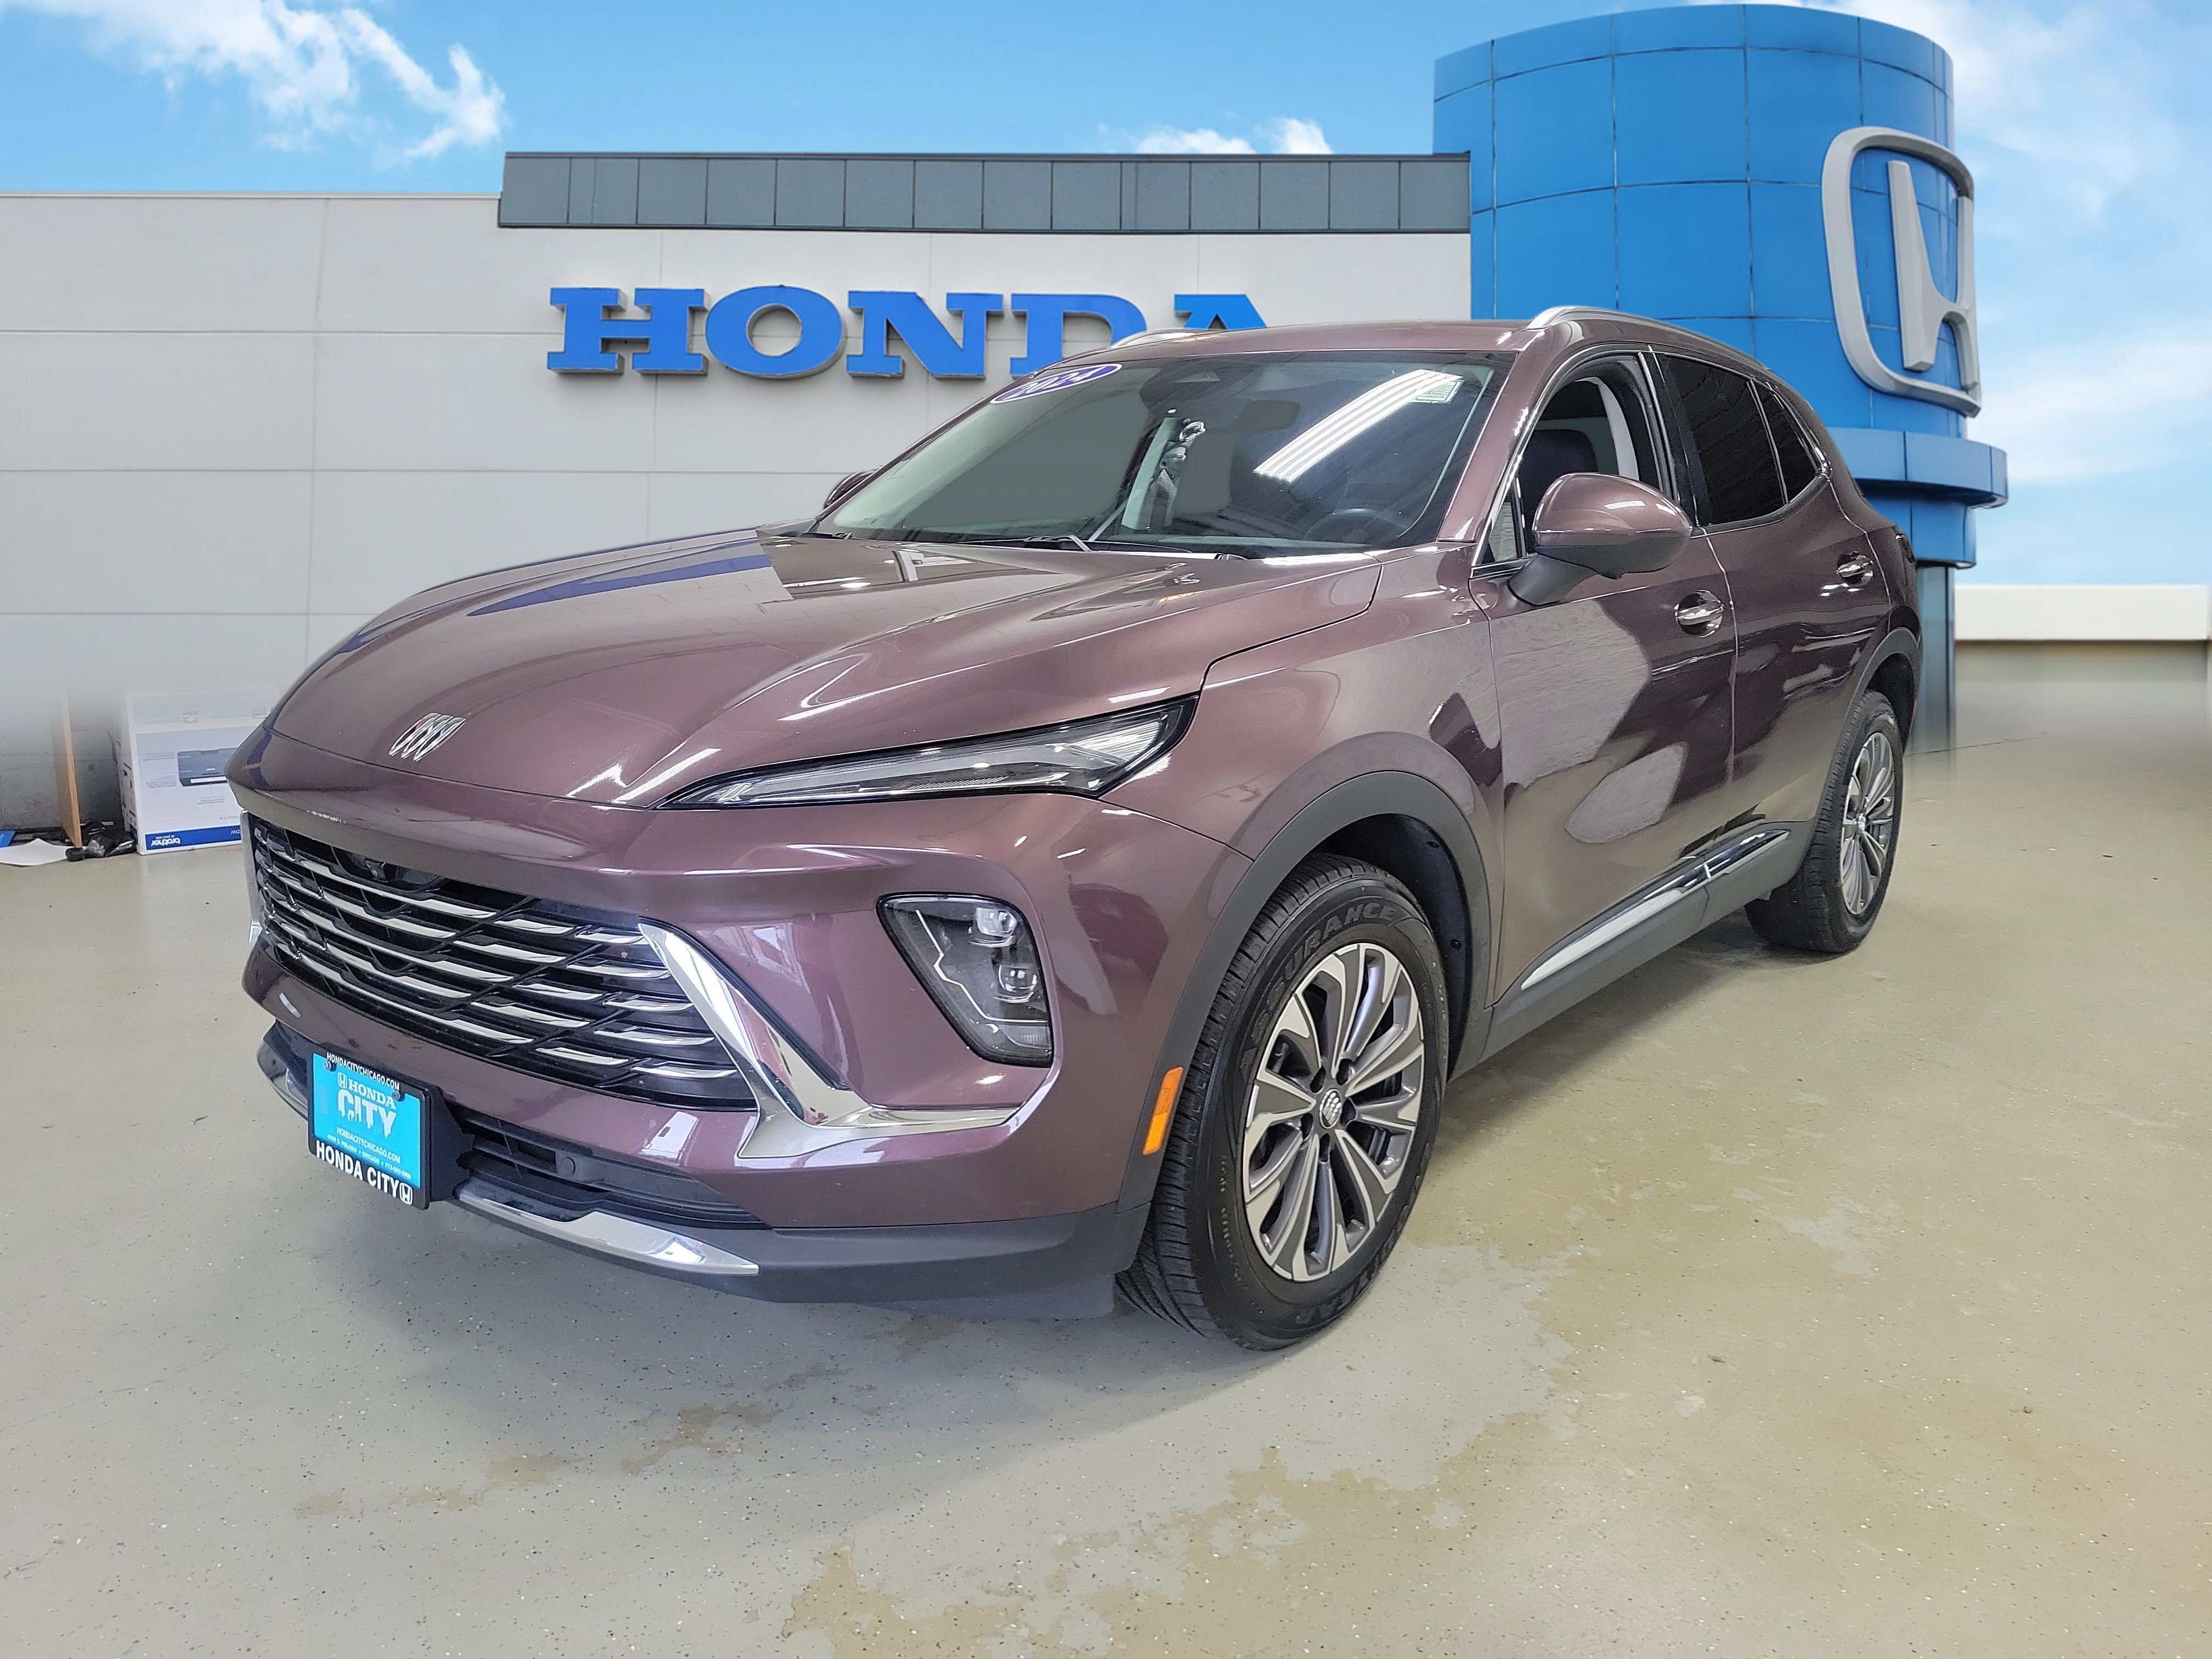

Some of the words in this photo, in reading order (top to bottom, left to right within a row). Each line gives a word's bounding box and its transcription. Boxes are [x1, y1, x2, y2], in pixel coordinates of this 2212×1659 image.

[1002, 366, 1107, 400] 2024
[150, 837, 181, 847] brother
[326, 1052, 400, 1091] HONDACITYCHICAGO.COM
[348, 1077, 397, 1110] HONDA
[337, 1089, 397, 1138] CITY
[336, 1126, 401, 1164] HONDACITYCHICAGO.COM
[316, 1139, 363, 1181] HONDA
[366, 1166, 400, 1198] CITY
